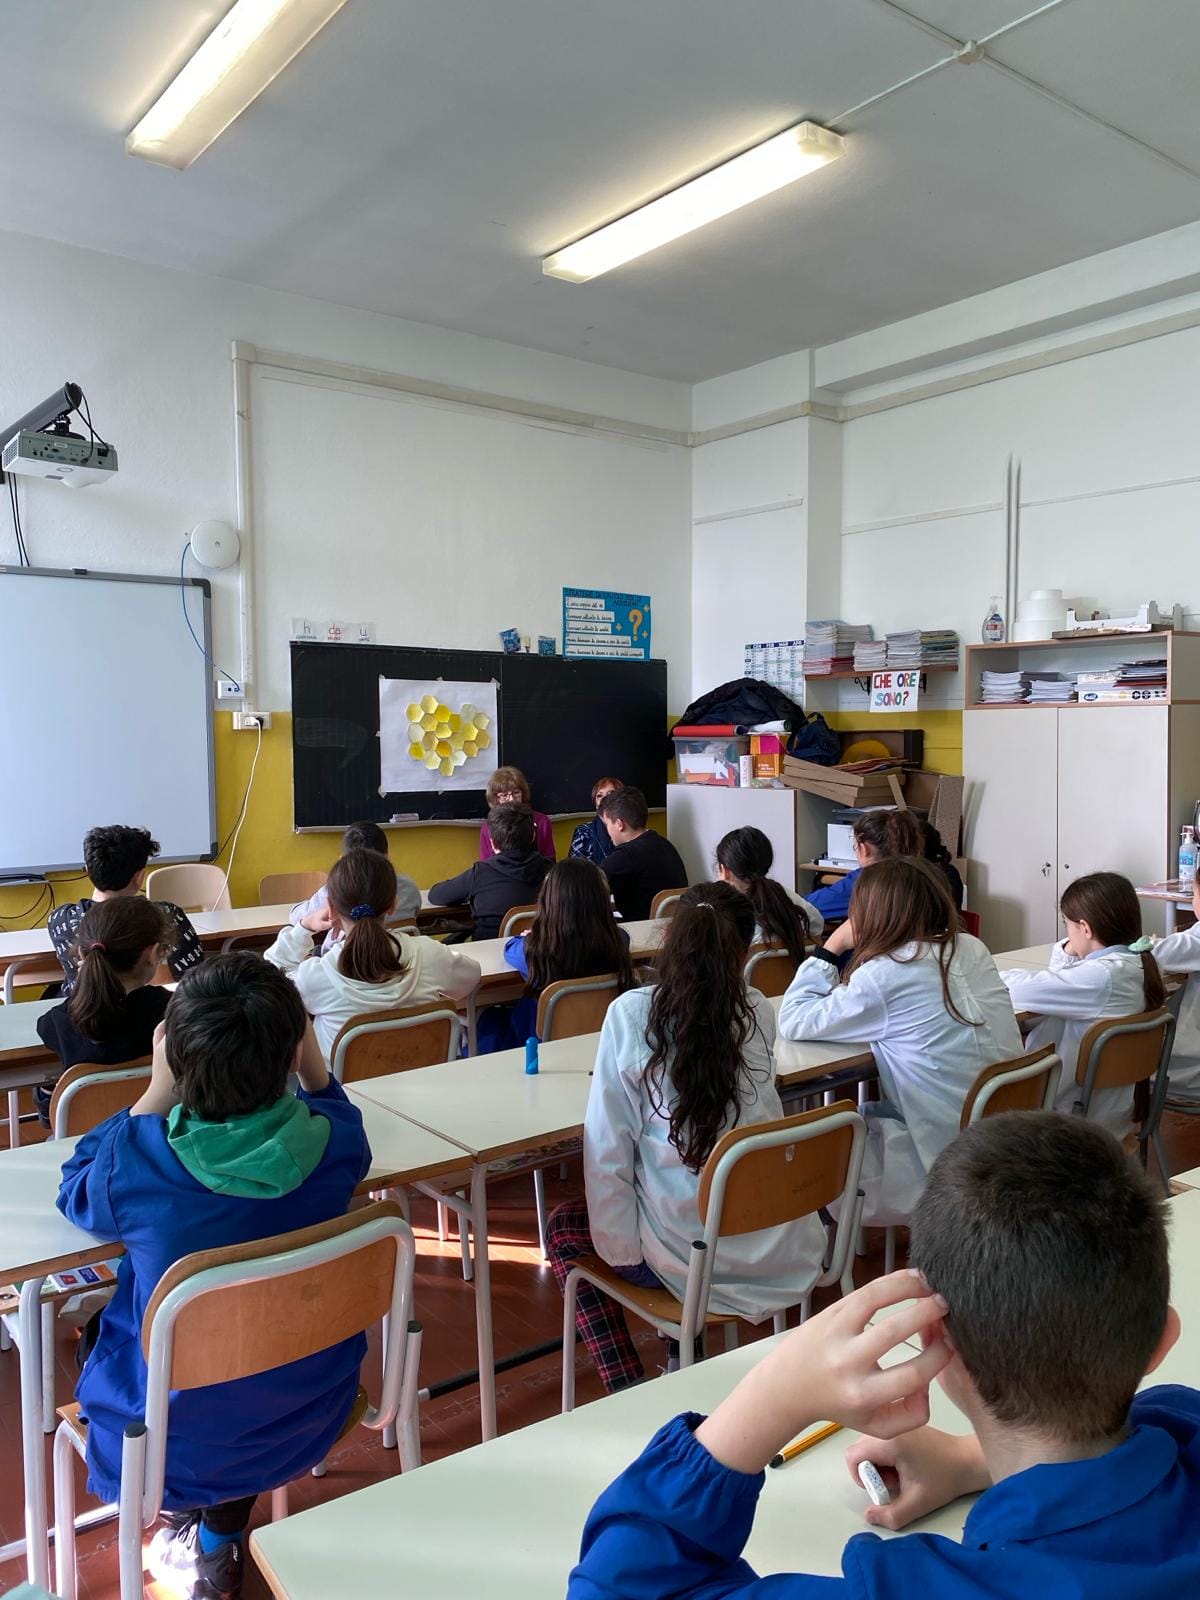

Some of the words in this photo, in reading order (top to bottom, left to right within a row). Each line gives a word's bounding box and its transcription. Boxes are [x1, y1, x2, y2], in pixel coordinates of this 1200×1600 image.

[873, 673, 892, 689] CHE
[897, 672, 917, 688] ORE
[874, 690, 909, 706] SONO?
